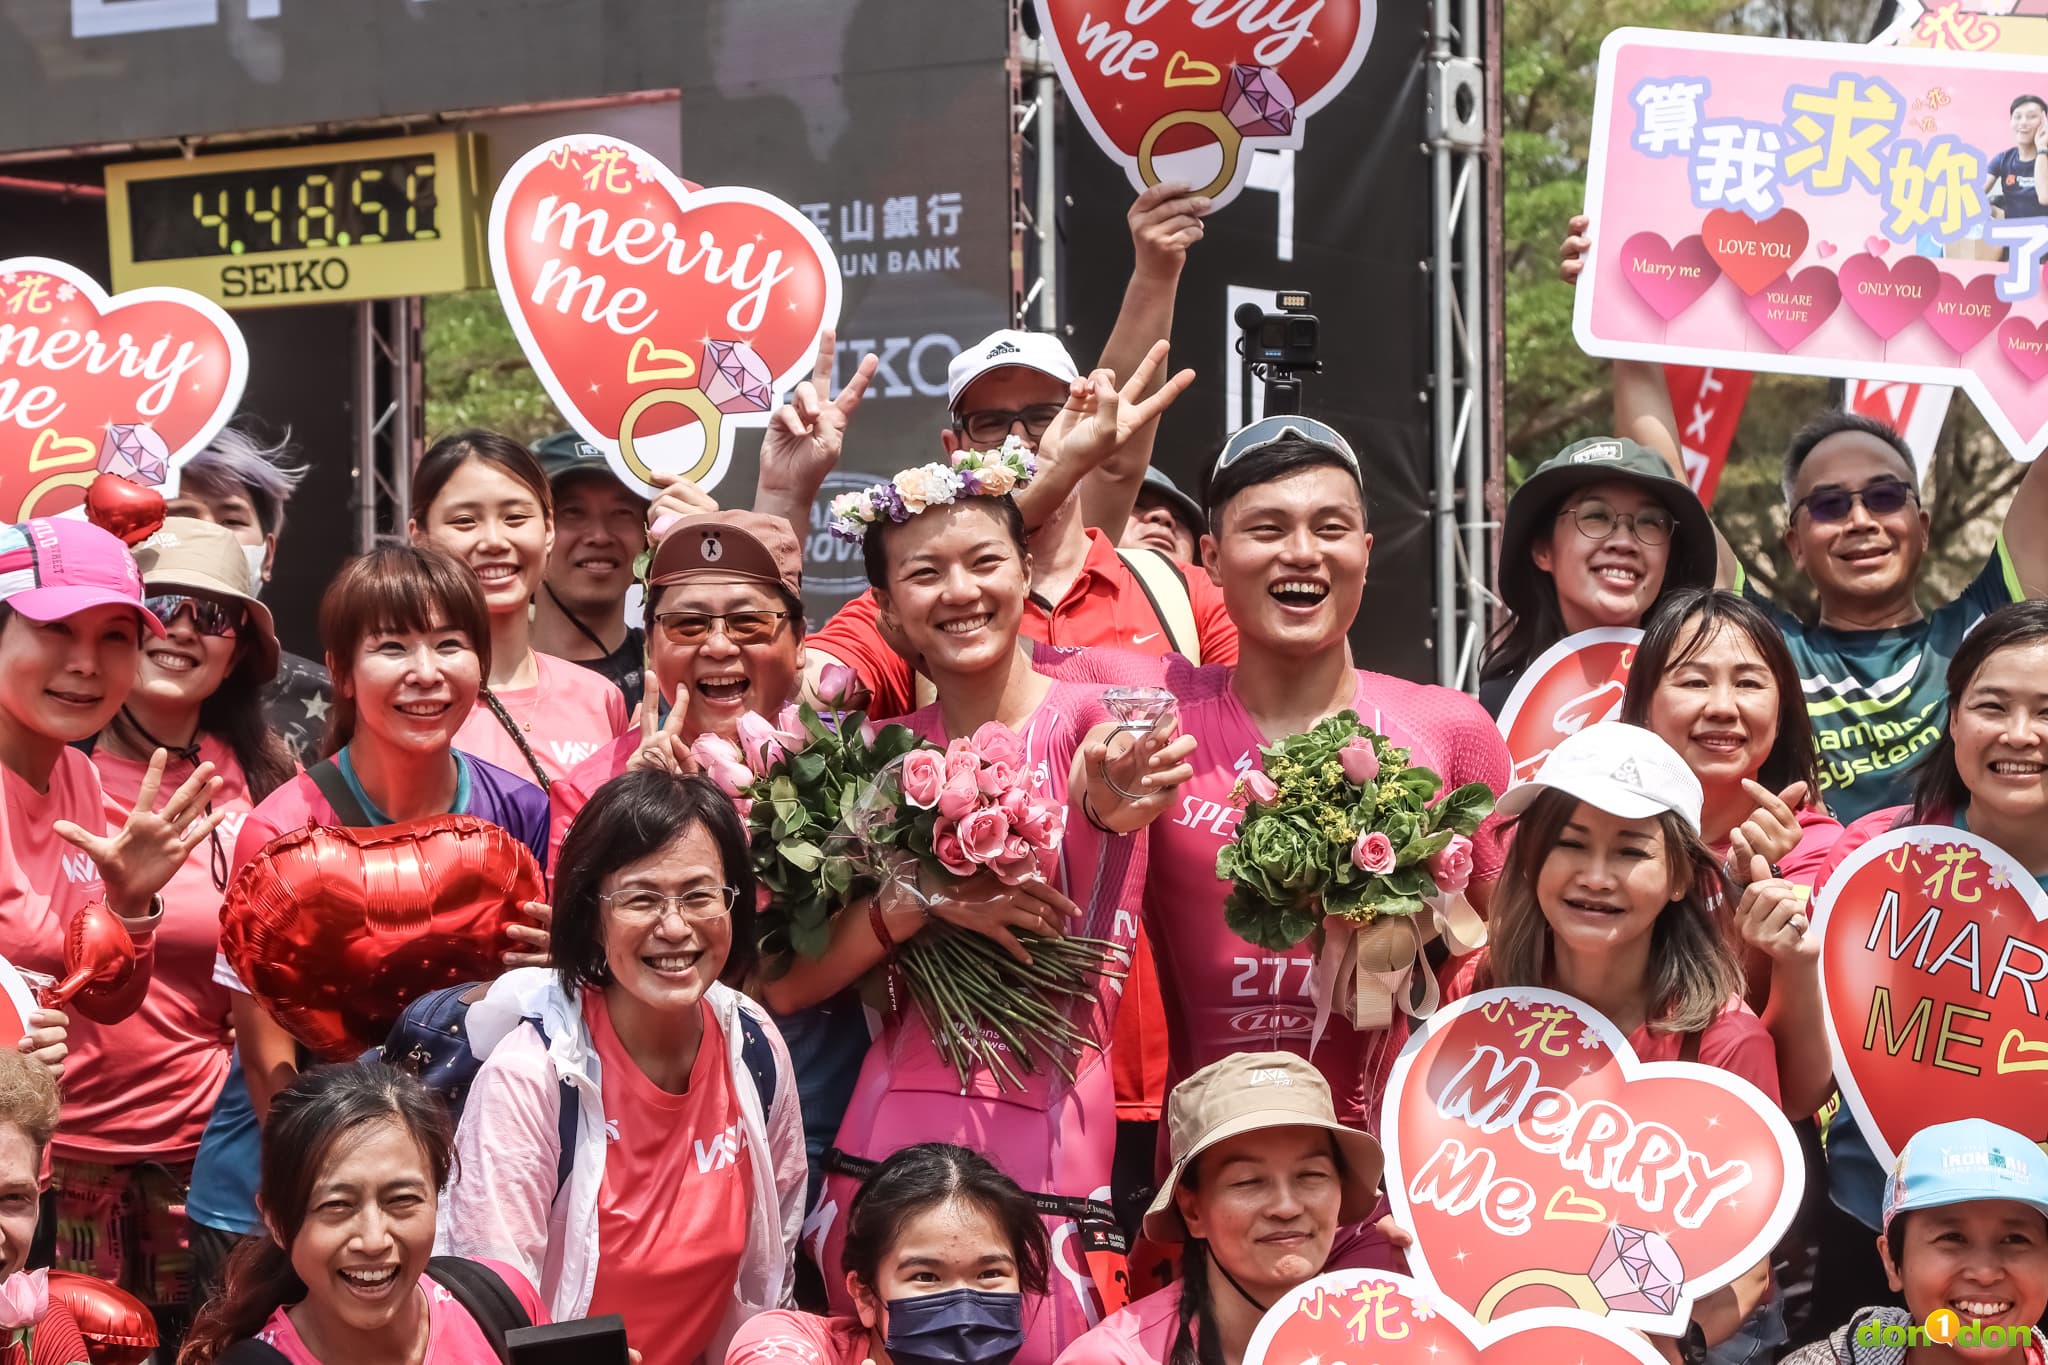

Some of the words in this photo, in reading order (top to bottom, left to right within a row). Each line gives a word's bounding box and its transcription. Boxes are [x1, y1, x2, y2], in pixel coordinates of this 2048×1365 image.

[1076, 13, 1159, 80] me
[549, 145, 632, 194] 小花
[530, 196, 794, 333] merry
[841, 253, 878, 277] UN
[887, 246, 961, 273] BANK
[1632, 257, 1676, 281] Marry
[1679, 262, 1701, 278] me
[1717, 238, 1757, 256] LOVE
[1760, 241, 1792, 259] YOU
[0, 273, 53, 315] 花
[220, 257, 350, 298] SEIKO
[530, 258, 659, 336] me
[1857, 281, 1892, 297] ONLY
[1894, 284, 1922, 299] YOU
[1766, 292, 1790, 306] YOU
[1790, 294, 1813, 307] ARE
[1766, 309, 1785, 322] MY
[1786, 310, 1809, 323] LIFE
[1937, 301, 1958, 316] MY
[1958, 303, 1992, 318] LOVE
[2007, 336, 2042, 355] Marry
[1172, 794, 1245, 839] SPE
[1884, 843, 1983, 903] 小花
[1864, 887, 2048, 1022] MAR
[1231, 956, 1312, 997] 277
[1480, 997, 1571, 1057] 小花
[1862, 985, 1991, 1077] ME
[1299, 1284, 1409, 1341] 小花
